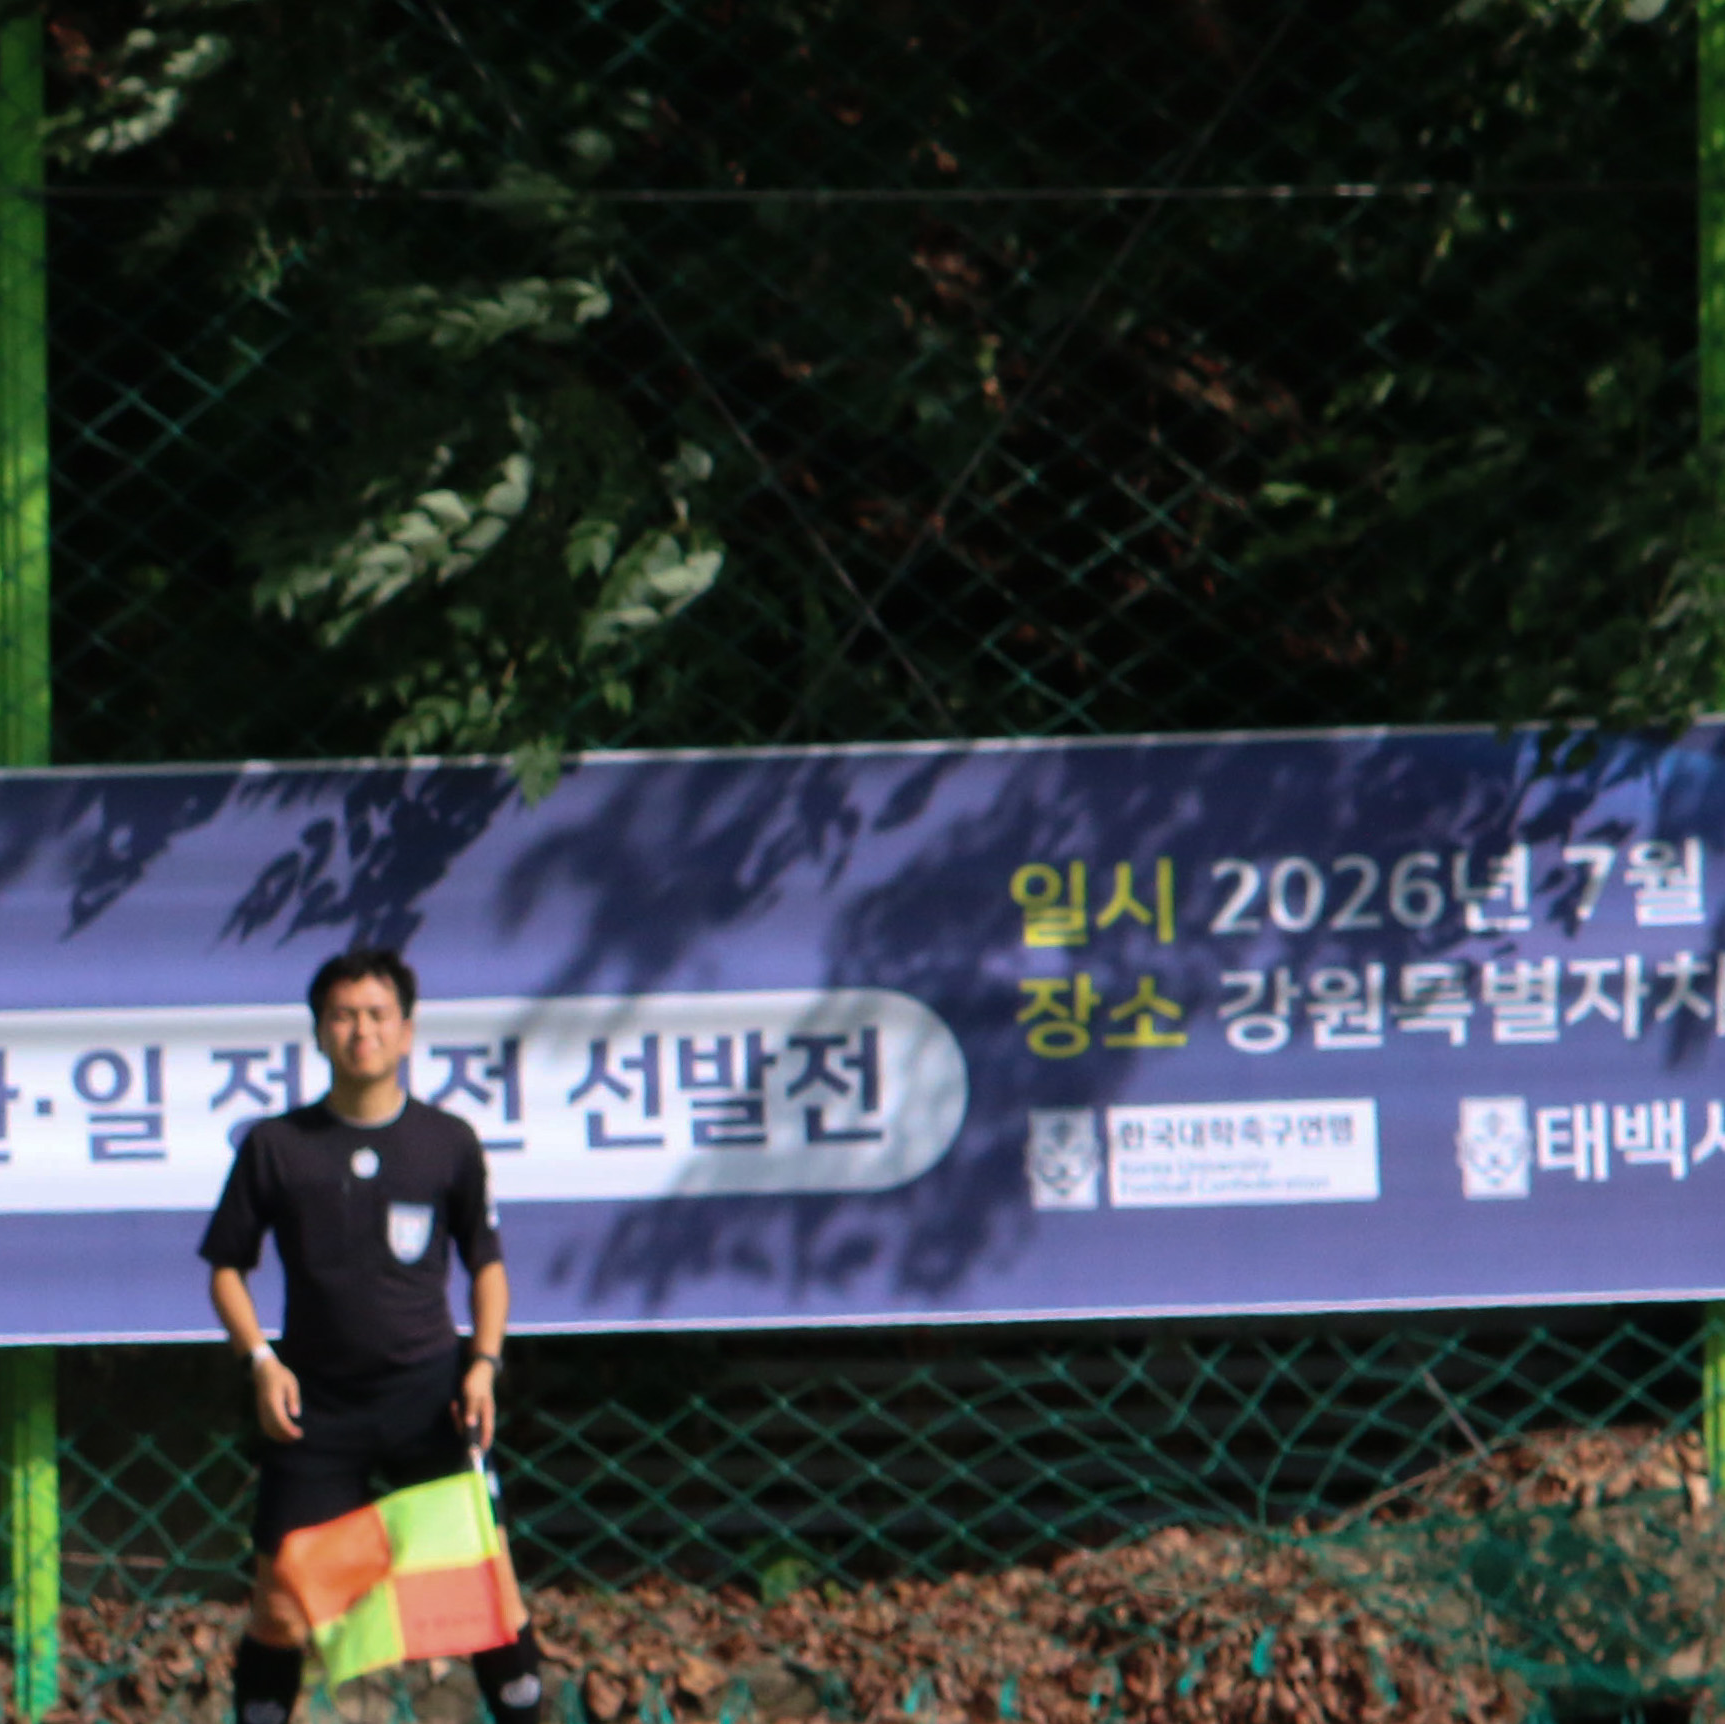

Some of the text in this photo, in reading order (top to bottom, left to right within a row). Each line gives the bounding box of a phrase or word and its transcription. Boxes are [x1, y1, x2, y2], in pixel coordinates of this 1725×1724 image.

[1010, 837, 1707, 948] 일시 2026년 7월
[1016, 973, 1188, 1058] 장소
[210, 1036, 525, 1152] 정전
[566, 1025, 885, 1150] 선발전
